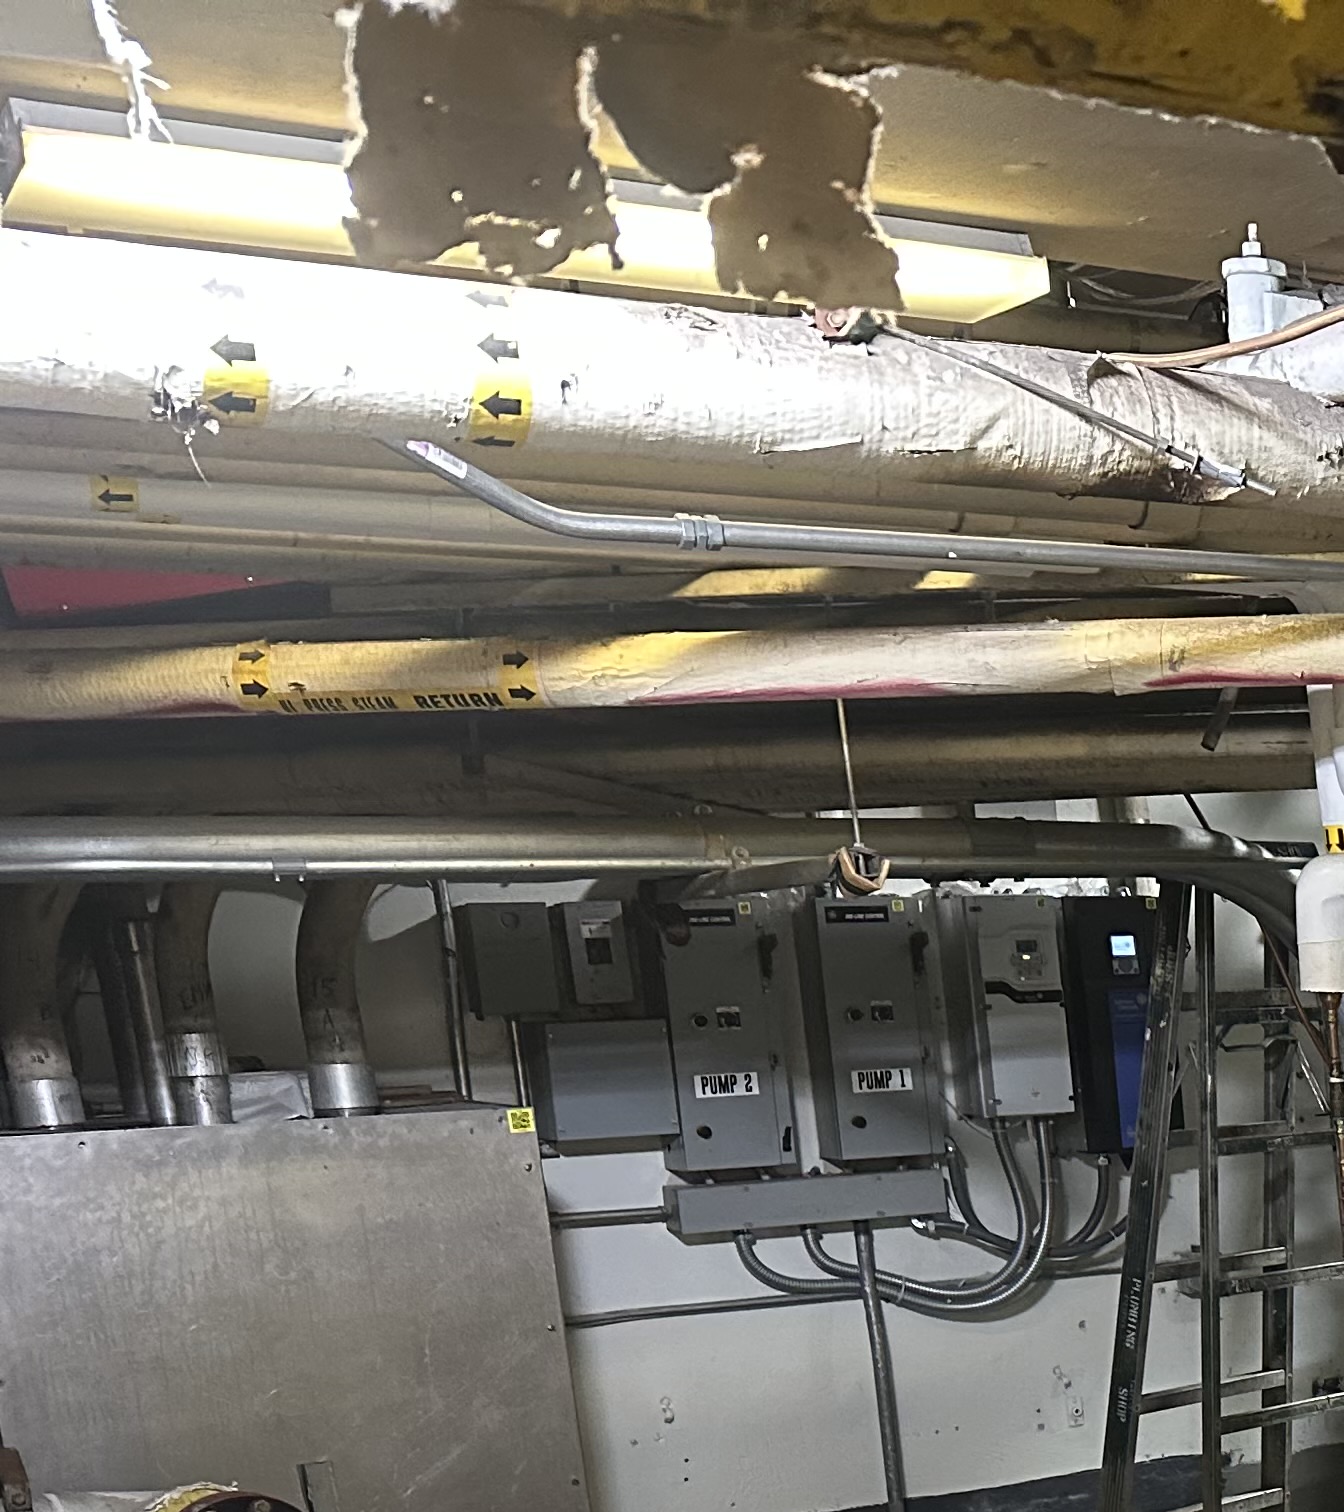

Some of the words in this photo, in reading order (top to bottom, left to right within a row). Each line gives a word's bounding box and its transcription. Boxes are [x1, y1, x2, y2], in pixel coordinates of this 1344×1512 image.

[413, 692, 505, 709] RETURN
[700, 1074, 738, 1096] PUMP
[744, 1073, 753, 1093] 2
[857, 1070, 892, 1091] PUMP
[899, 1069, 907, 1088] 1
